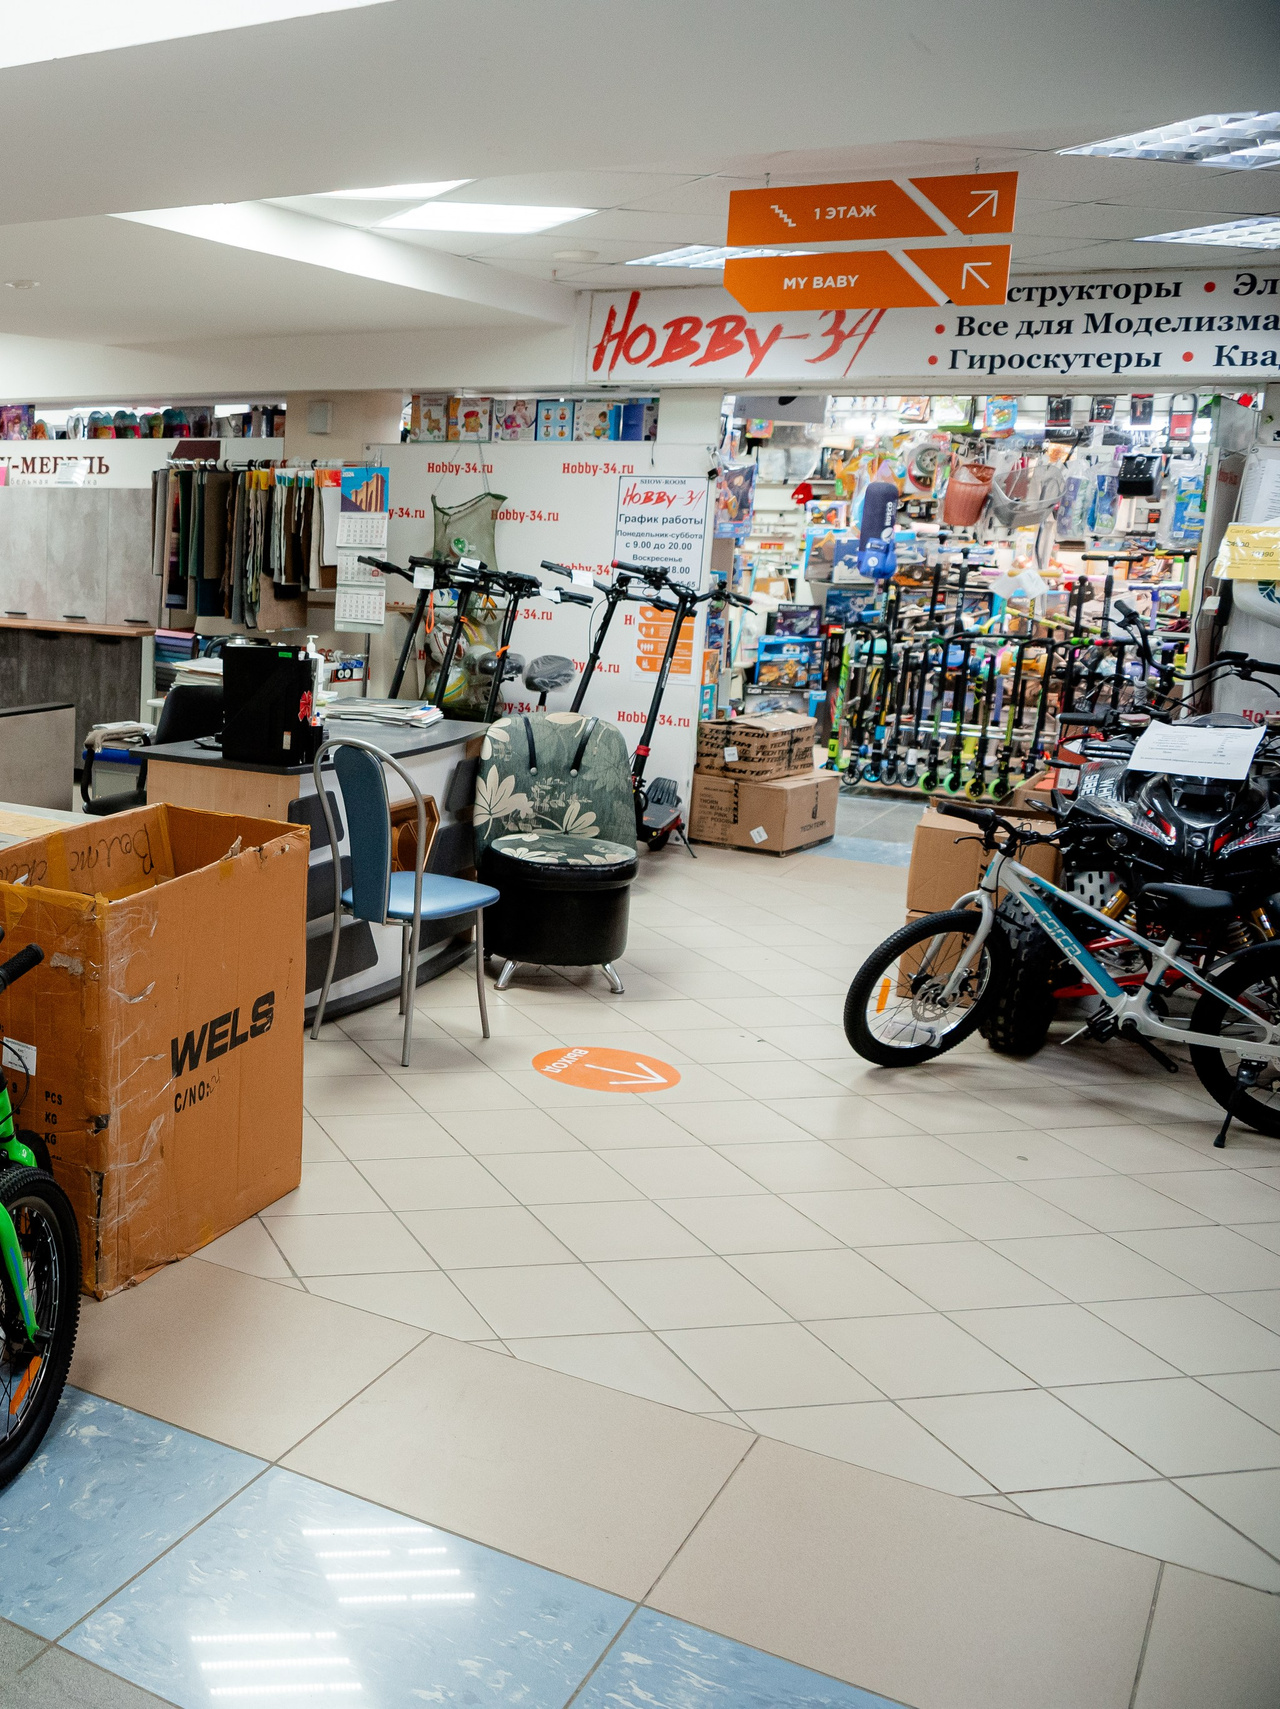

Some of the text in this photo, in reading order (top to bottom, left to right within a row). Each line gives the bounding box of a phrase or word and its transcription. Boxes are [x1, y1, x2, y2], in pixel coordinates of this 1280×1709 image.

[814, 204, 877, 220] 1 ЭТАЖ
[783, 274, 859, 290] MY BABY
[955, 312, 1280, 340] Все для Моделизма
[948, 344, 1280, 374] Гироскутеры Ква
[427, 462, 493, 476] Hobby-34.ru
[562, 462, 634, 476] Hobby-34.ru
[491, 508, 559, 523] Hobby-34.ru
[619, 513, 703, 526] График работы
[632, 541, 652, 549] 9.00
[653, 542, 666, 551] до
[668, 542, 693, 551] 20.00
[632, 554, 683, 563] Воскресенье
[617, 711, 690, 727] Hobb-34.ru
[170, 990, 275, 1079] WELS
[540, 1048, 590, 1074] ВЫХОД
[45, 1091, 63, 1105] PCS
[45, 1112, 58, 1125] KG
